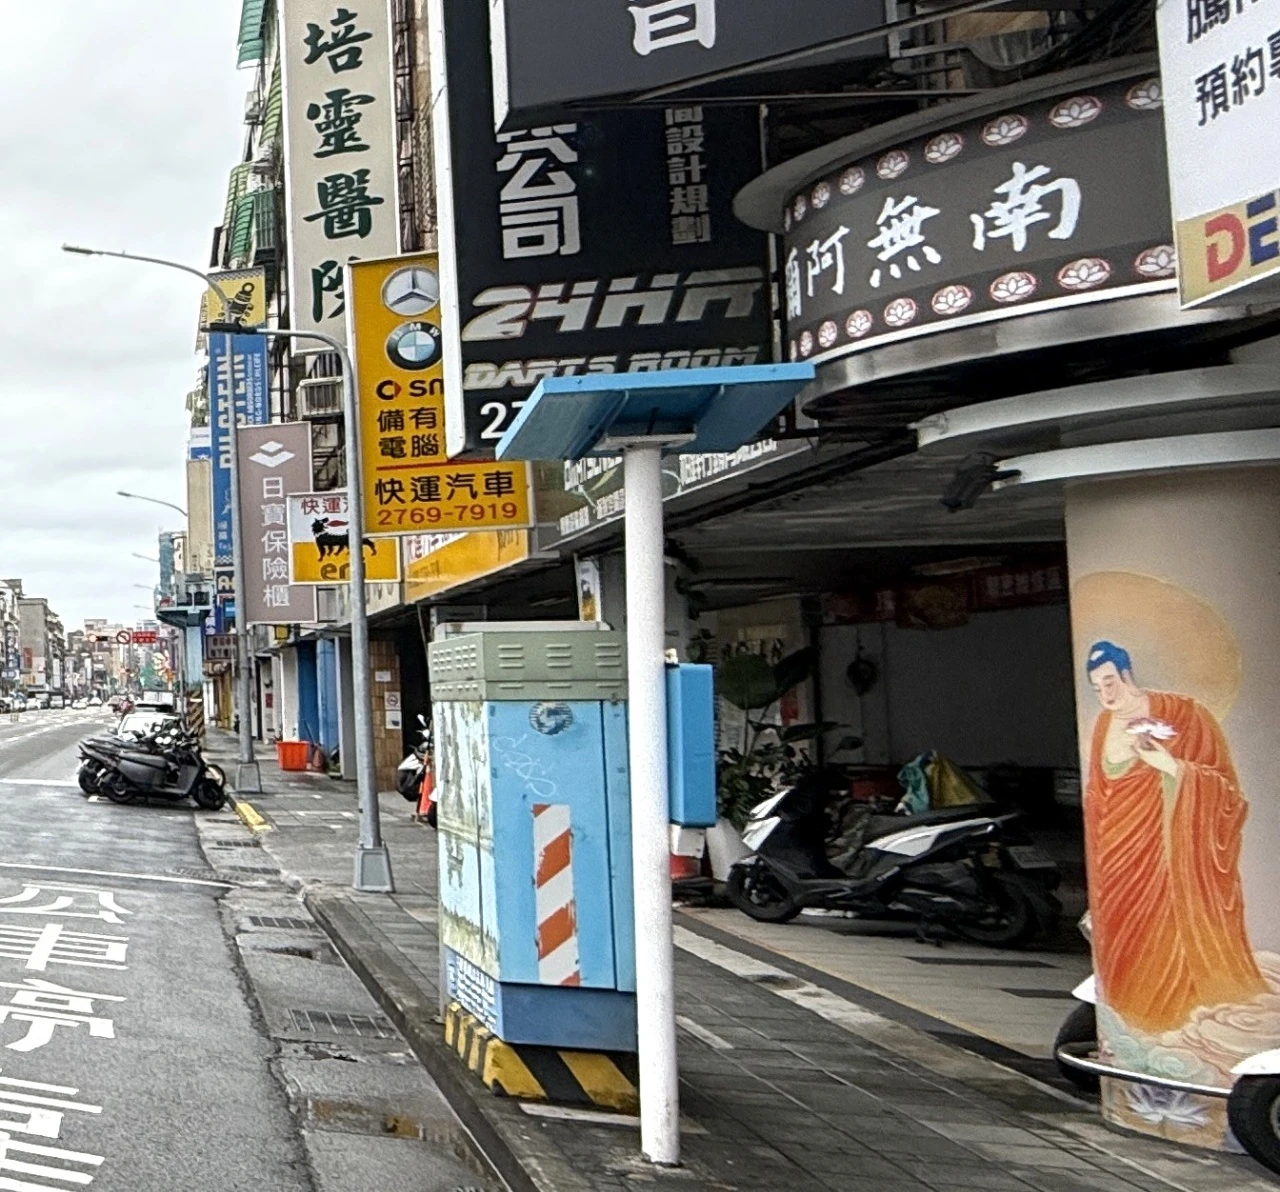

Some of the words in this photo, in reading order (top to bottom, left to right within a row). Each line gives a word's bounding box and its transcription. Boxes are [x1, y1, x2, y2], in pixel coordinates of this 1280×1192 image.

[496, 123, 582, 259] 公司
[377, 407, 438, 434] 備有
[378, 434, 440, 461] 電腦
[374, 471, 516, 506] 快運汽車
[301, 496, 352, 516] 快運
[377, 502, 518, 526] 2769-7919
[260, 476, 290, 608] 日寶保險櫃
